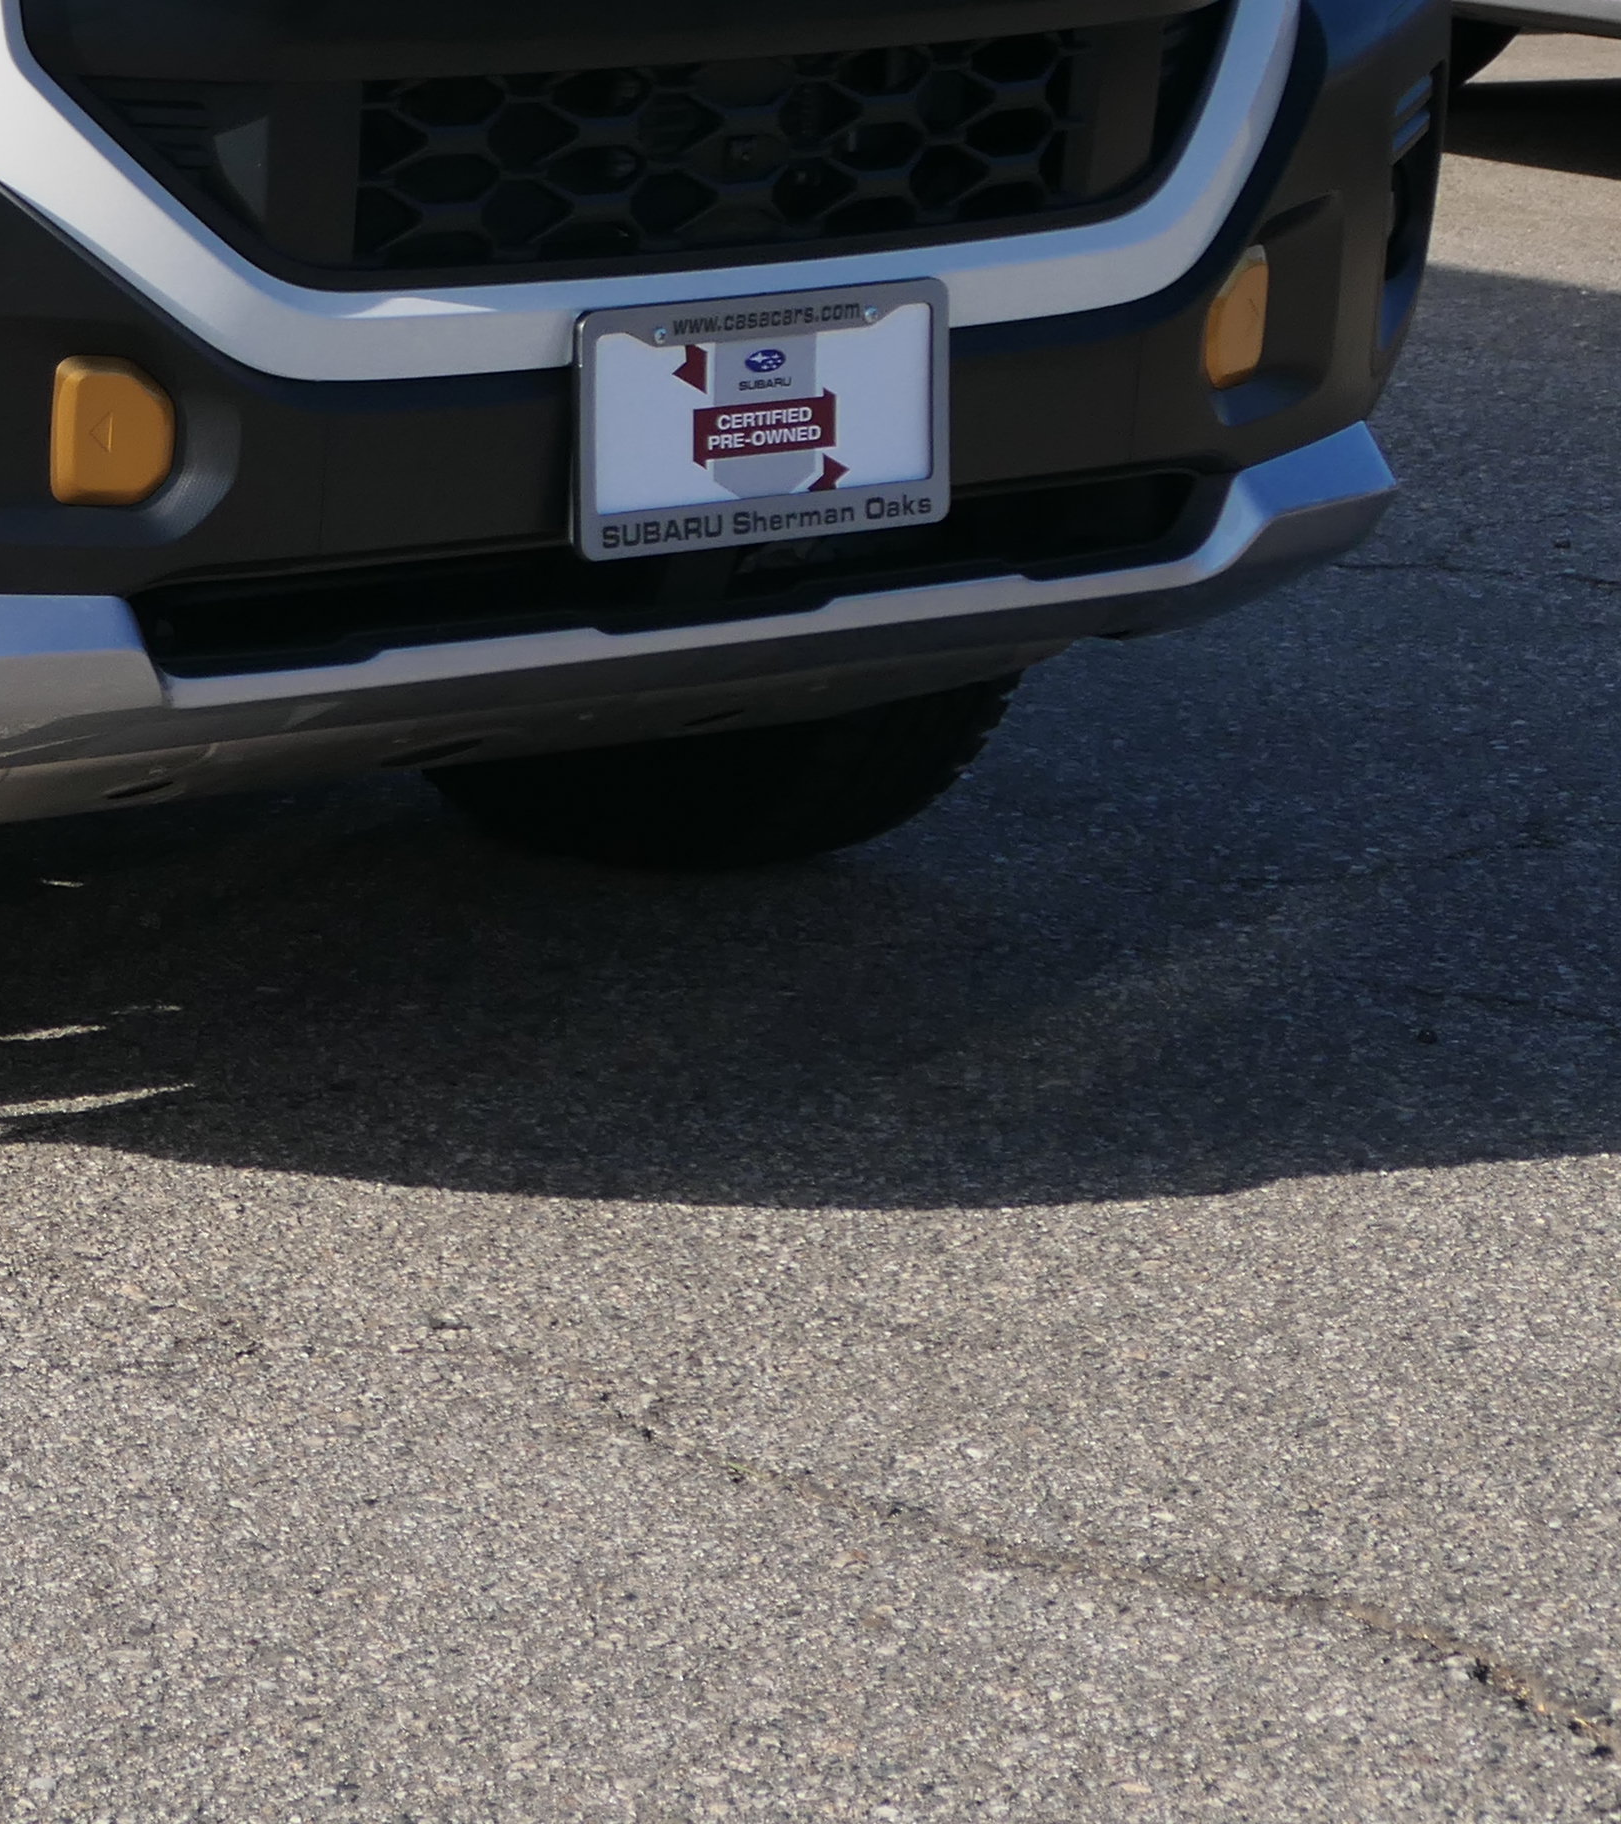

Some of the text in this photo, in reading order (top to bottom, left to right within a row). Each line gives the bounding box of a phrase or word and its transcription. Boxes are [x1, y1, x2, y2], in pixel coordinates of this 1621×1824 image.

[672, 301, 861, 336] www.casacars.com
[738, 376, 792, 391] SUBARU
[717, 407, 812, 431] CERTIFIED
[707, 425, 822, 450] PRE-OWNED
[602, 494, 932, 550] SUBARU Sherman Oaks
